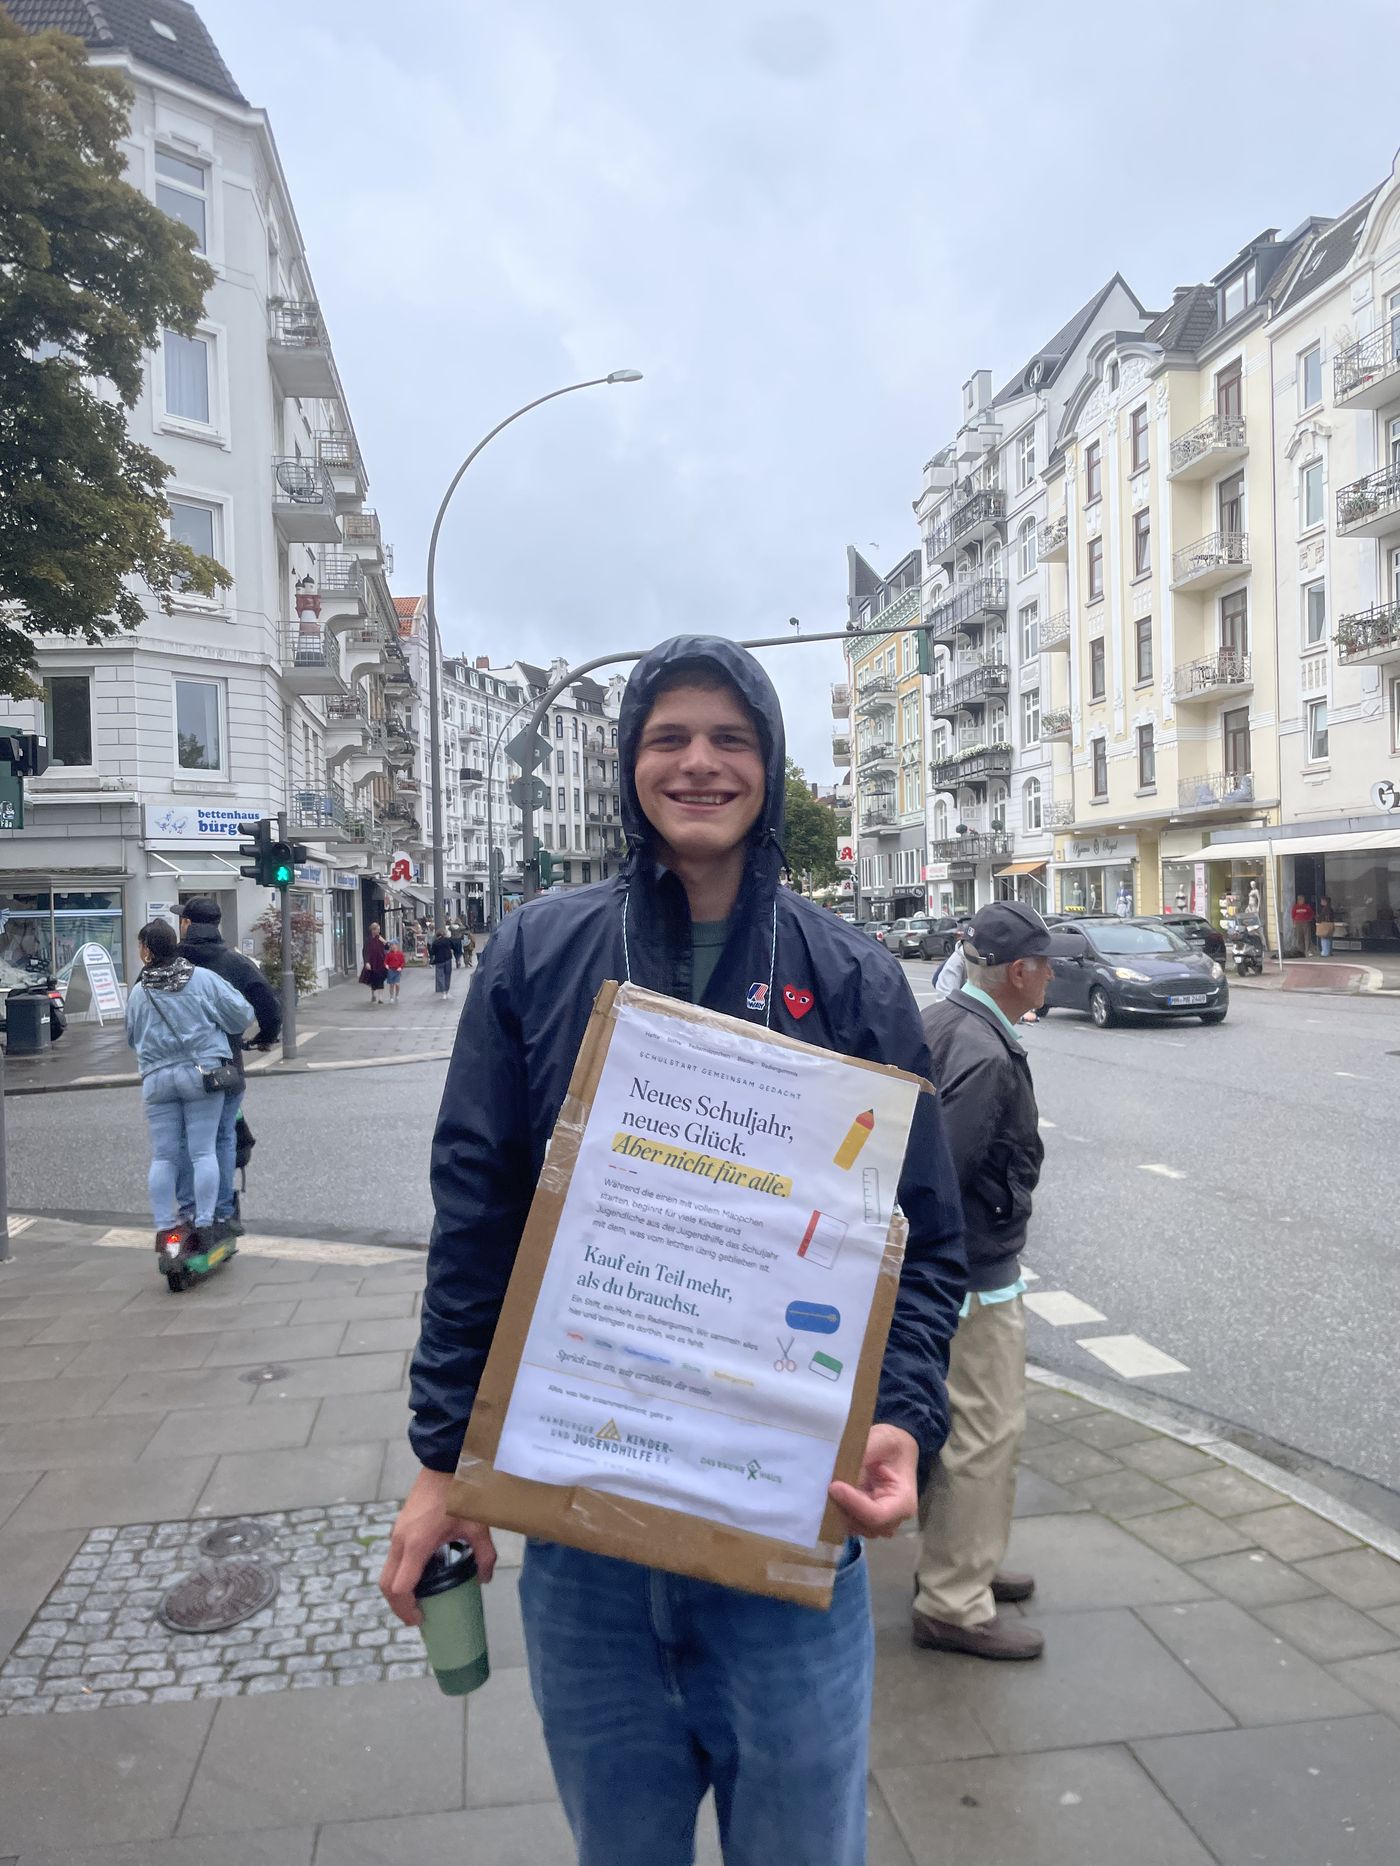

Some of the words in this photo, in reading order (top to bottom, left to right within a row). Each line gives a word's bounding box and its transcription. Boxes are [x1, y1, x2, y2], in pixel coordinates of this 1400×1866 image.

[198, 809, 260, 820] bettenhaus
[1371, 781, 1400, 811] G
[199, 820, 241, 836] bürg
[748, 1001, 764, 1010] WAY
[639, 1050, 698, 1072] SCHULSTART
[701, 1067, 755, 1088] GEMEINSAM
[758, 1083, 801, 1100] GEDACHT
[629, 1077, 692, 1112] Neues
[695, 1095, 793, 1144] Schuljahr,
[622, 1111, 681, 1138] neues
[684, 1122, 746, 1157] Glück.
[611, 1134, 664, 1162] Aber
[663, 1151, 714, 1177] nicht
[712, 1160, 748, 1185] für
[747, 1172, 786, 1198] alle.
[600, 1191, 629, 1207] starten,
[631, 1199, 664, 1215] beginnt
[664, 1208, 677, 1218] für
[677, 1214, 697, 1224] viele
[698, 1217, 724, 1231] Kinder
[724, 1226, 742, 1236] und
[604, 1178, 641, 1195] Während
[640, 1188, 655, 1199] die
[655, 1192, 678, 1204] einen
[679, 1199, 693, 1209] mit
[693, 1203, 720, 1216] vollem
[722, 1209, 764, 1228] Mäppchen
[592, 1219, 607, 1229] mit
[606, 1222, 627, 1236] dem,
[629, 1229, 646, 1240] was
[646, 1234, 665, 1244] vom
[666, 1237, 694, 1252] letzten
[695, 1246, 717, 1261] übrig
[717, 1253, 758, 1268] geblieben
[595, 1205, 646, 1225] Jugendliche
[645, 1219, 661, 1229] aus
[661, 1222, 677, 1233] der
[675, 1226, 725, 1246] Jugendhilfe
[725, 1239, 740, 1250] das
[740, 1243, 779, 1261] Schuljahr
[576, 1270, 601, 1290] als
[602, 1276, 624, 1297] du
[626, 1281, 700, 1317] brauchst.
[584, 1244, 626, 1271] Kauf
[625, 1260, 650, 1278] ein
[655, 1263, 685, 1287] Teil
[686, 1278, 732, 1302] mehr,
[572, 1433, 653, 1463] JUGENDHILFE
[625, 1433, 673, 1454] KINDER-
